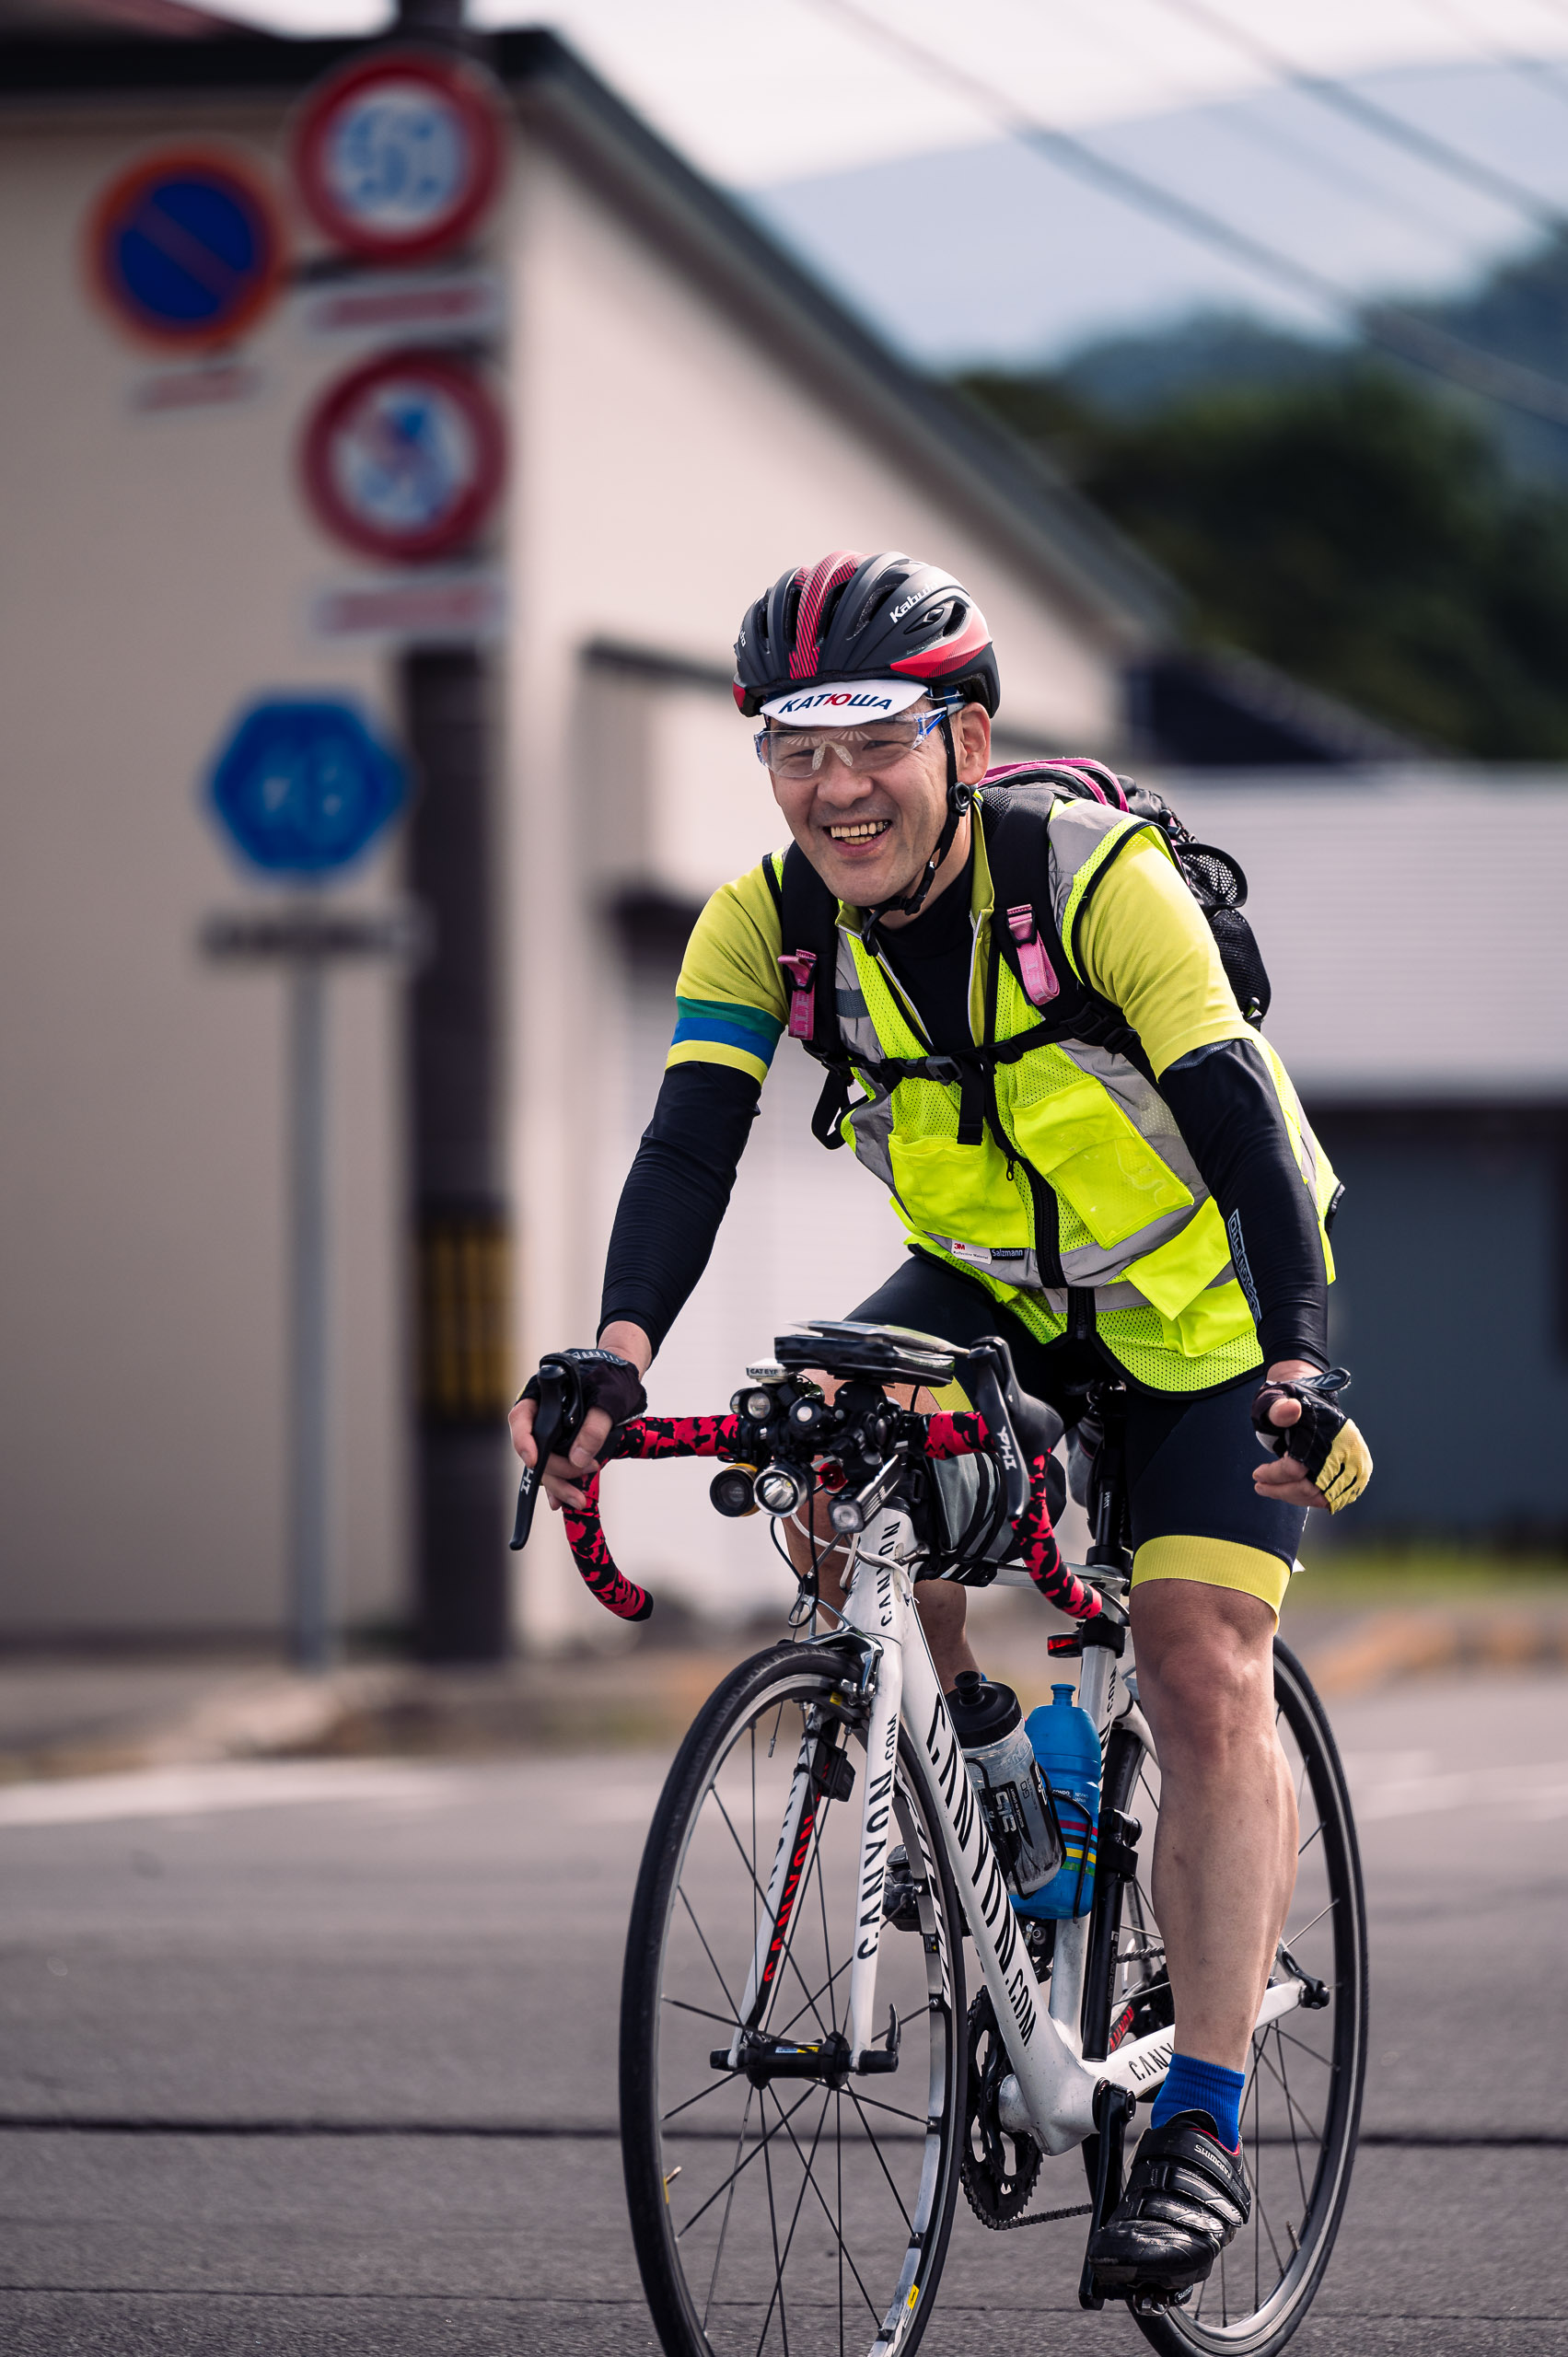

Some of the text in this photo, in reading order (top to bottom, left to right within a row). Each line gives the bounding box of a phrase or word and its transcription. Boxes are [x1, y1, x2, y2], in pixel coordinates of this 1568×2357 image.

[778, 692, 893, 714] КАТЮША
[992, 1248, 1023, 1258] Salzmann
[1020, 1780, 1029, 1799] GO
[1129, 2042, 1175, 2081] CANY
